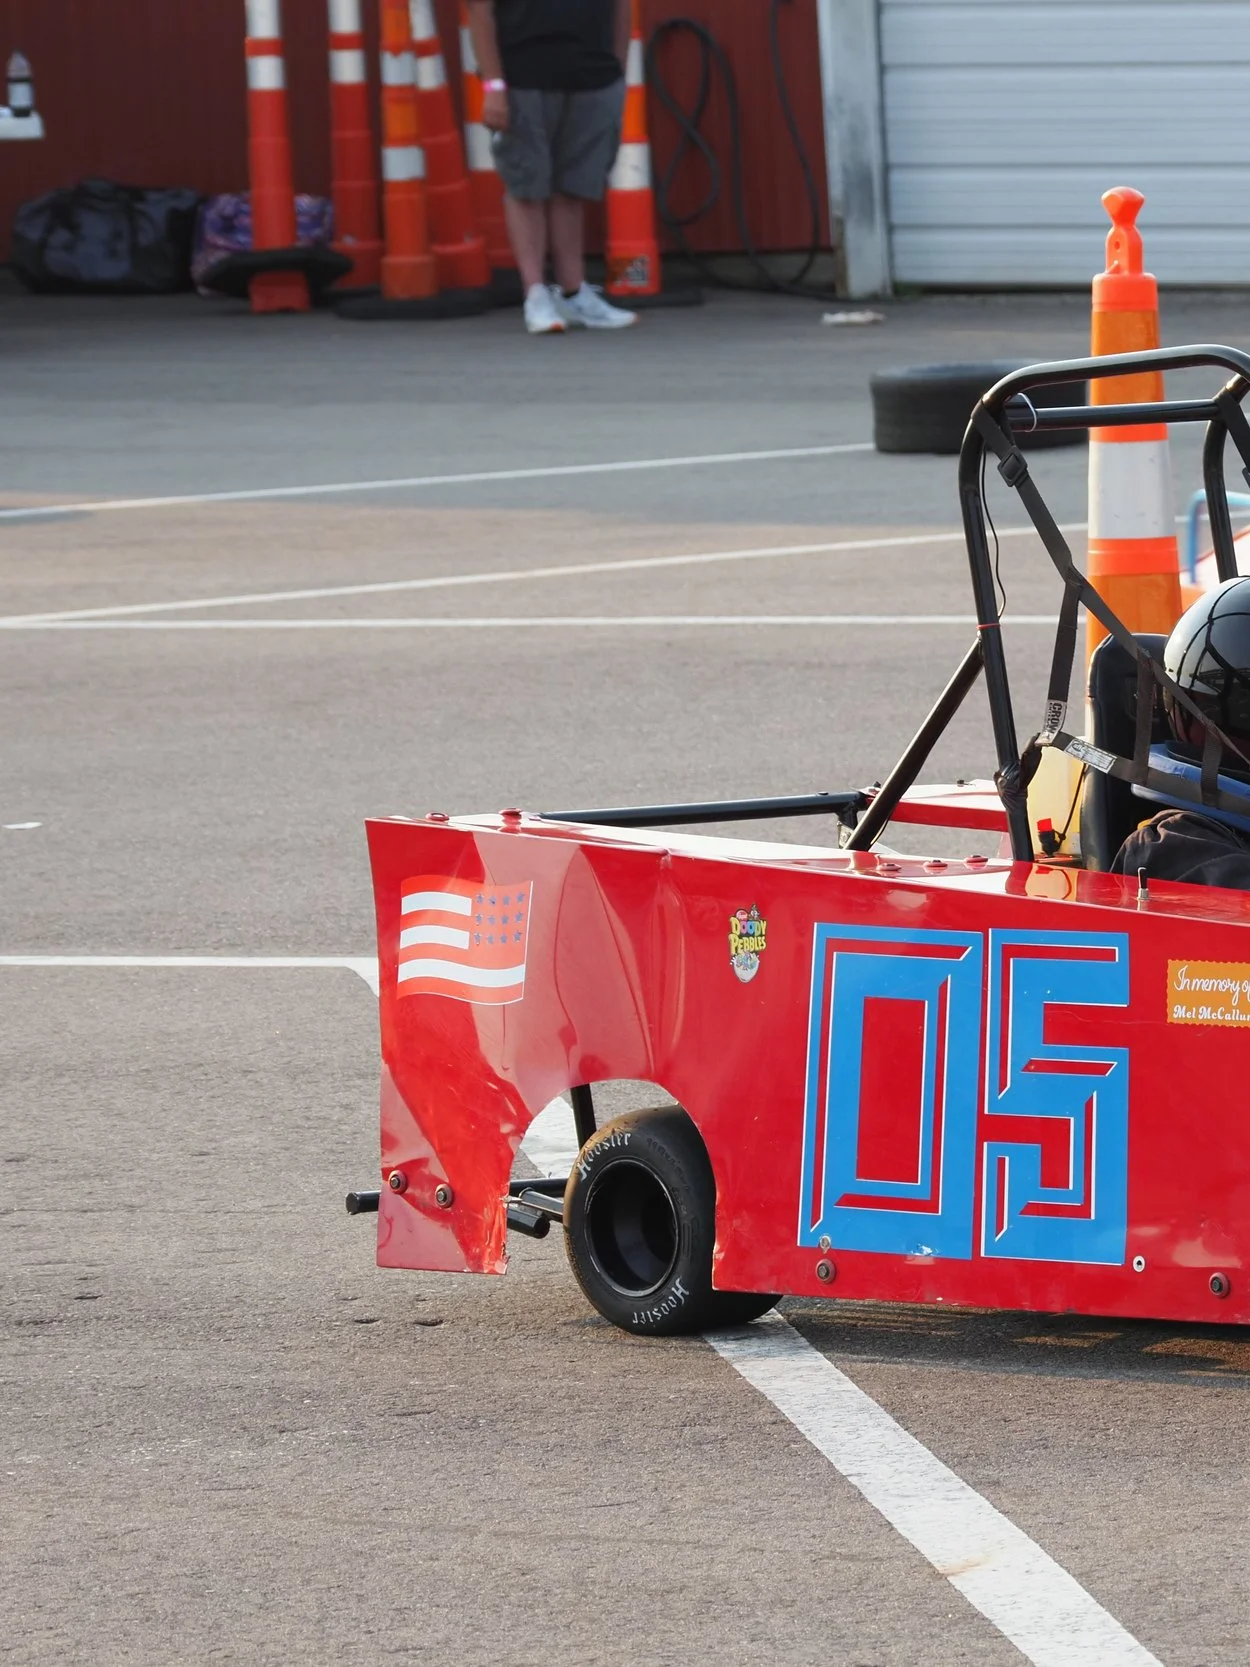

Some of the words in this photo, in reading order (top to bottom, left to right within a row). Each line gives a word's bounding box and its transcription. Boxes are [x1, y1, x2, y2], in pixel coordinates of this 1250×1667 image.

[728, 933, 767, 956] PEBBLES
[1191, 978, 1240, 1006] memory
[1172, 1004, 1196, 1019] Mel
[797, 922, 1130, 1265] 05
[576, 1132, 631, 1182] Hoosier
[632, 1276, 690, 1325] Hoosier
